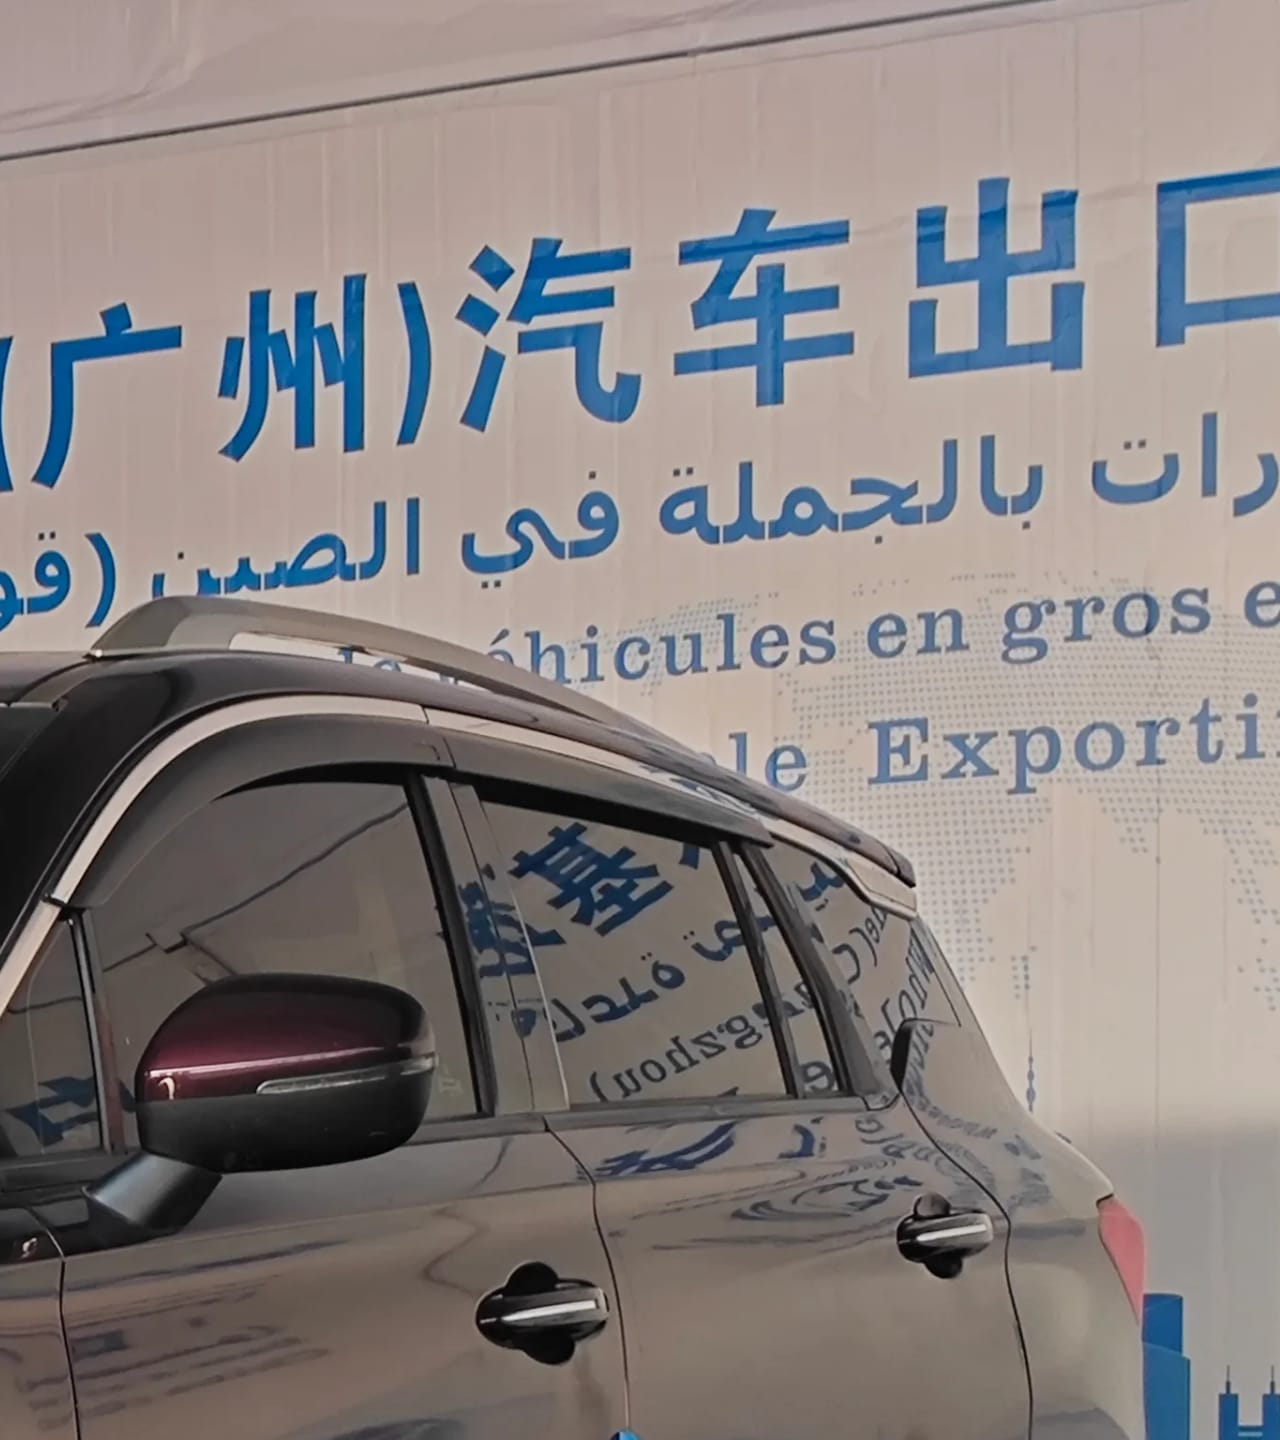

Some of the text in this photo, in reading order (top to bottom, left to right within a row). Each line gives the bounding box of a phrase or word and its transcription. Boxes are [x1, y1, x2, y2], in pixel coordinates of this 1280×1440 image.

[462, 472, 619, 588] في
[659, 436, 1043, 543] بالجملة
[488, 613, 837, 686] hicules
[867, 608, 968, 658] en
[1001, 586, 1211, 664] gros
[868, 694, 1280, 793] Exporti
